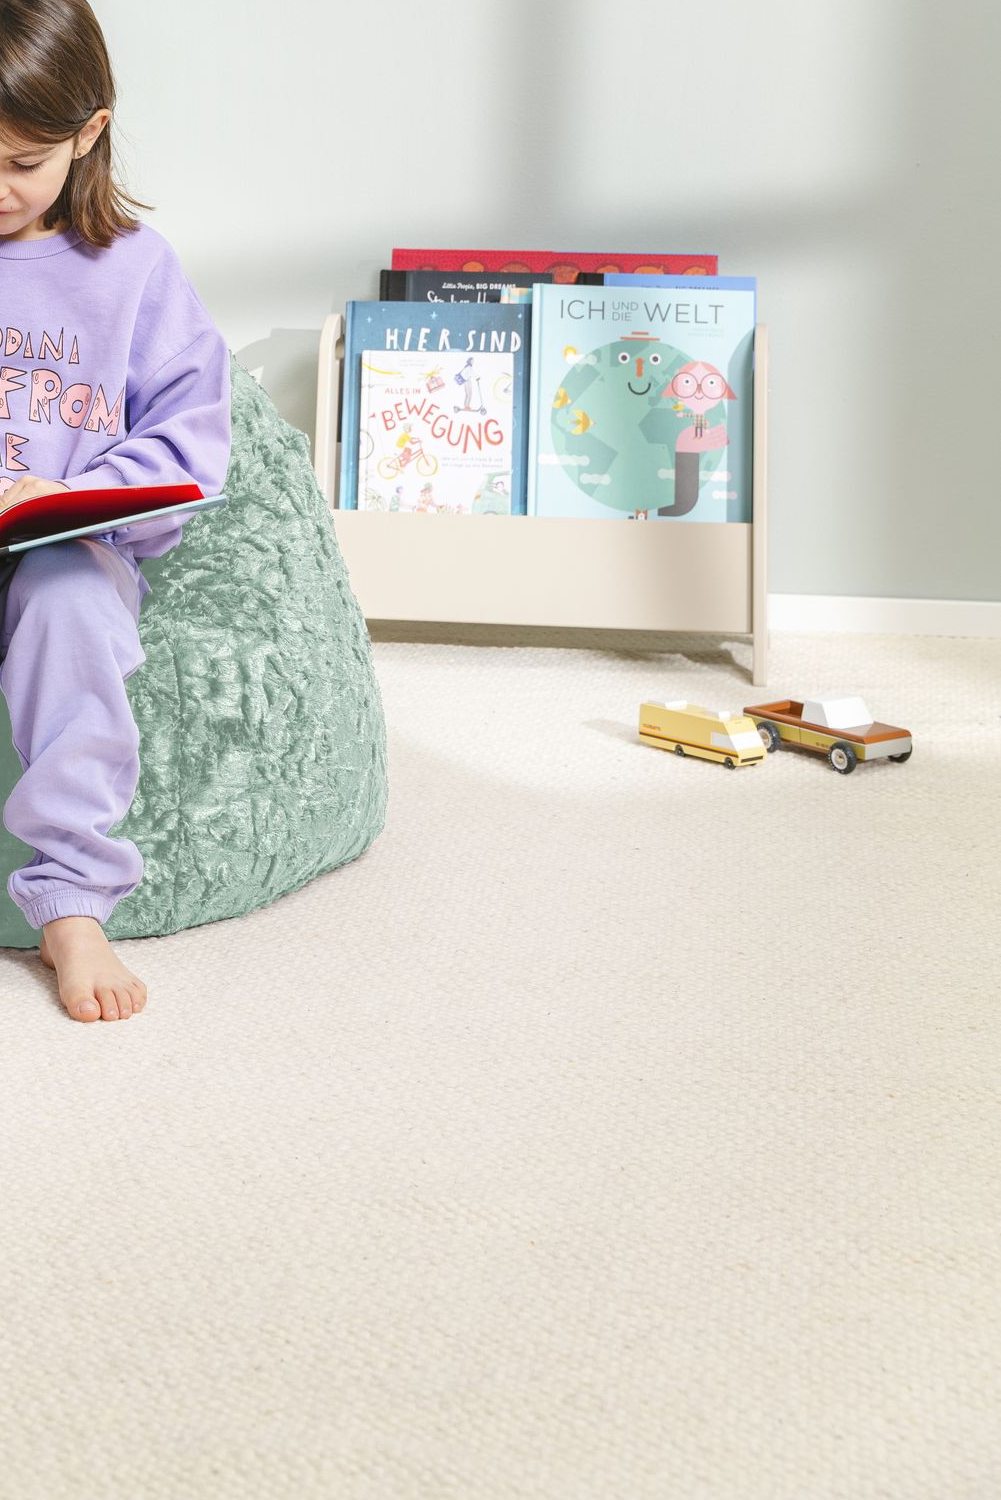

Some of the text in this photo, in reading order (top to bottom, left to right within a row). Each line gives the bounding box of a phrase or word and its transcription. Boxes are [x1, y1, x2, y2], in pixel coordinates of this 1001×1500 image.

[560, 299, 724, 324] ICH UND DIE WELT
[386, 327, 521, 352] HIER SIND
[382, 398, 504, 453] BEWEGUNG
